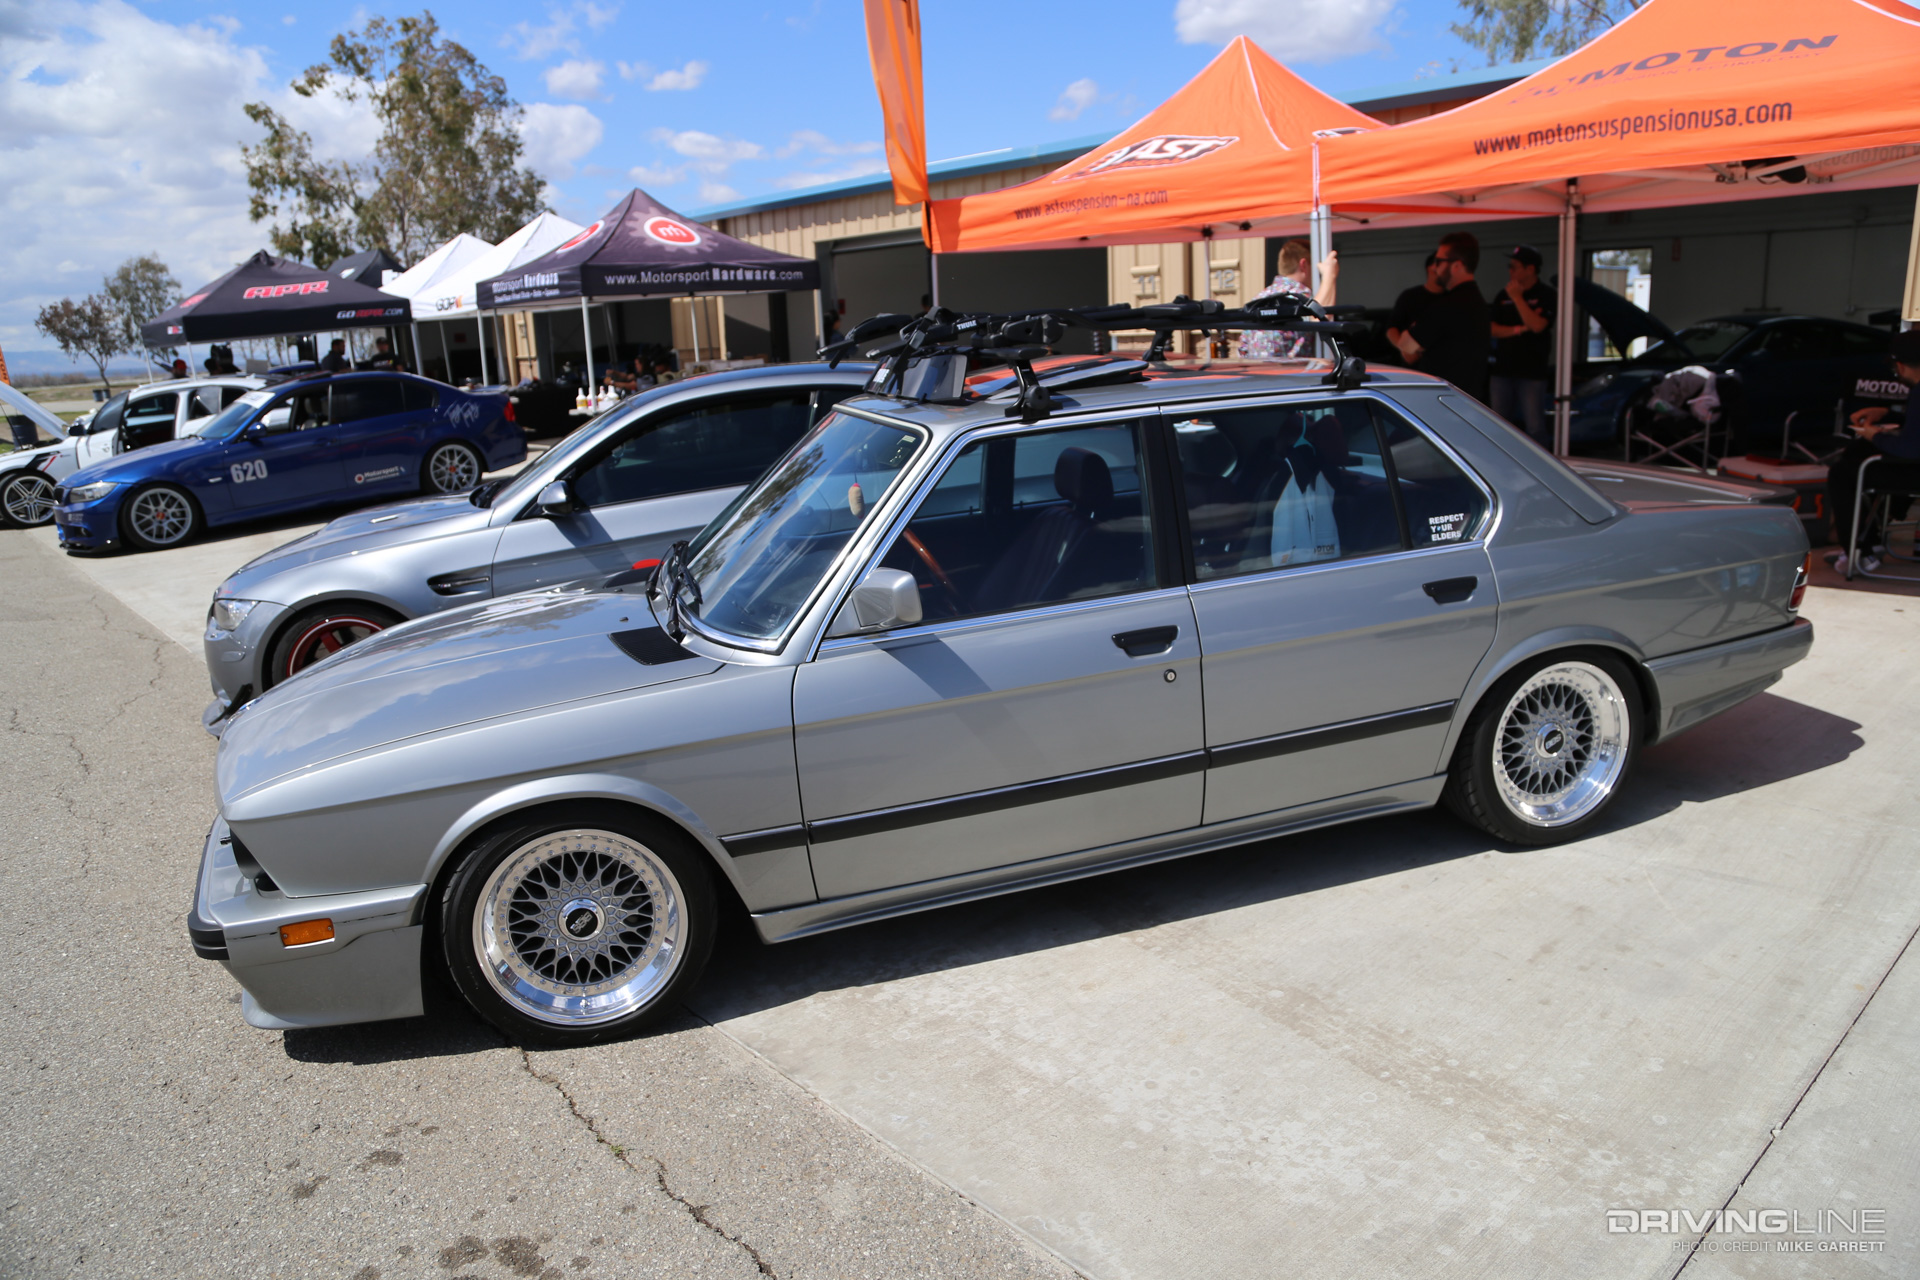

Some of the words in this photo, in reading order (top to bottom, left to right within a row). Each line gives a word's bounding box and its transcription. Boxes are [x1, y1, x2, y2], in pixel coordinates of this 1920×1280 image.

[1576, 34, 1839, 85] MOTON
[1474, 101, 1793, 156] www.motonsuspensionusa.com
[1114, 138, 1229, 164] AST
[1014, 189, 1169, 220] www.astsuspension-na.com
[1138, 275, 1156, 293] 11
[1215, 269, 1235, 289] 12
[243, 280, 329, 300] APR
[956, 320, 977, 330] THULE
[1855, 379, 1910, 395] MOTON
[230, 459, 268, 484] 620
[1429, 513, 1465, 525] RESPECT
[1431, 530, 1462, 542] ELDERS
[570, 911, 593, 934] BBS
